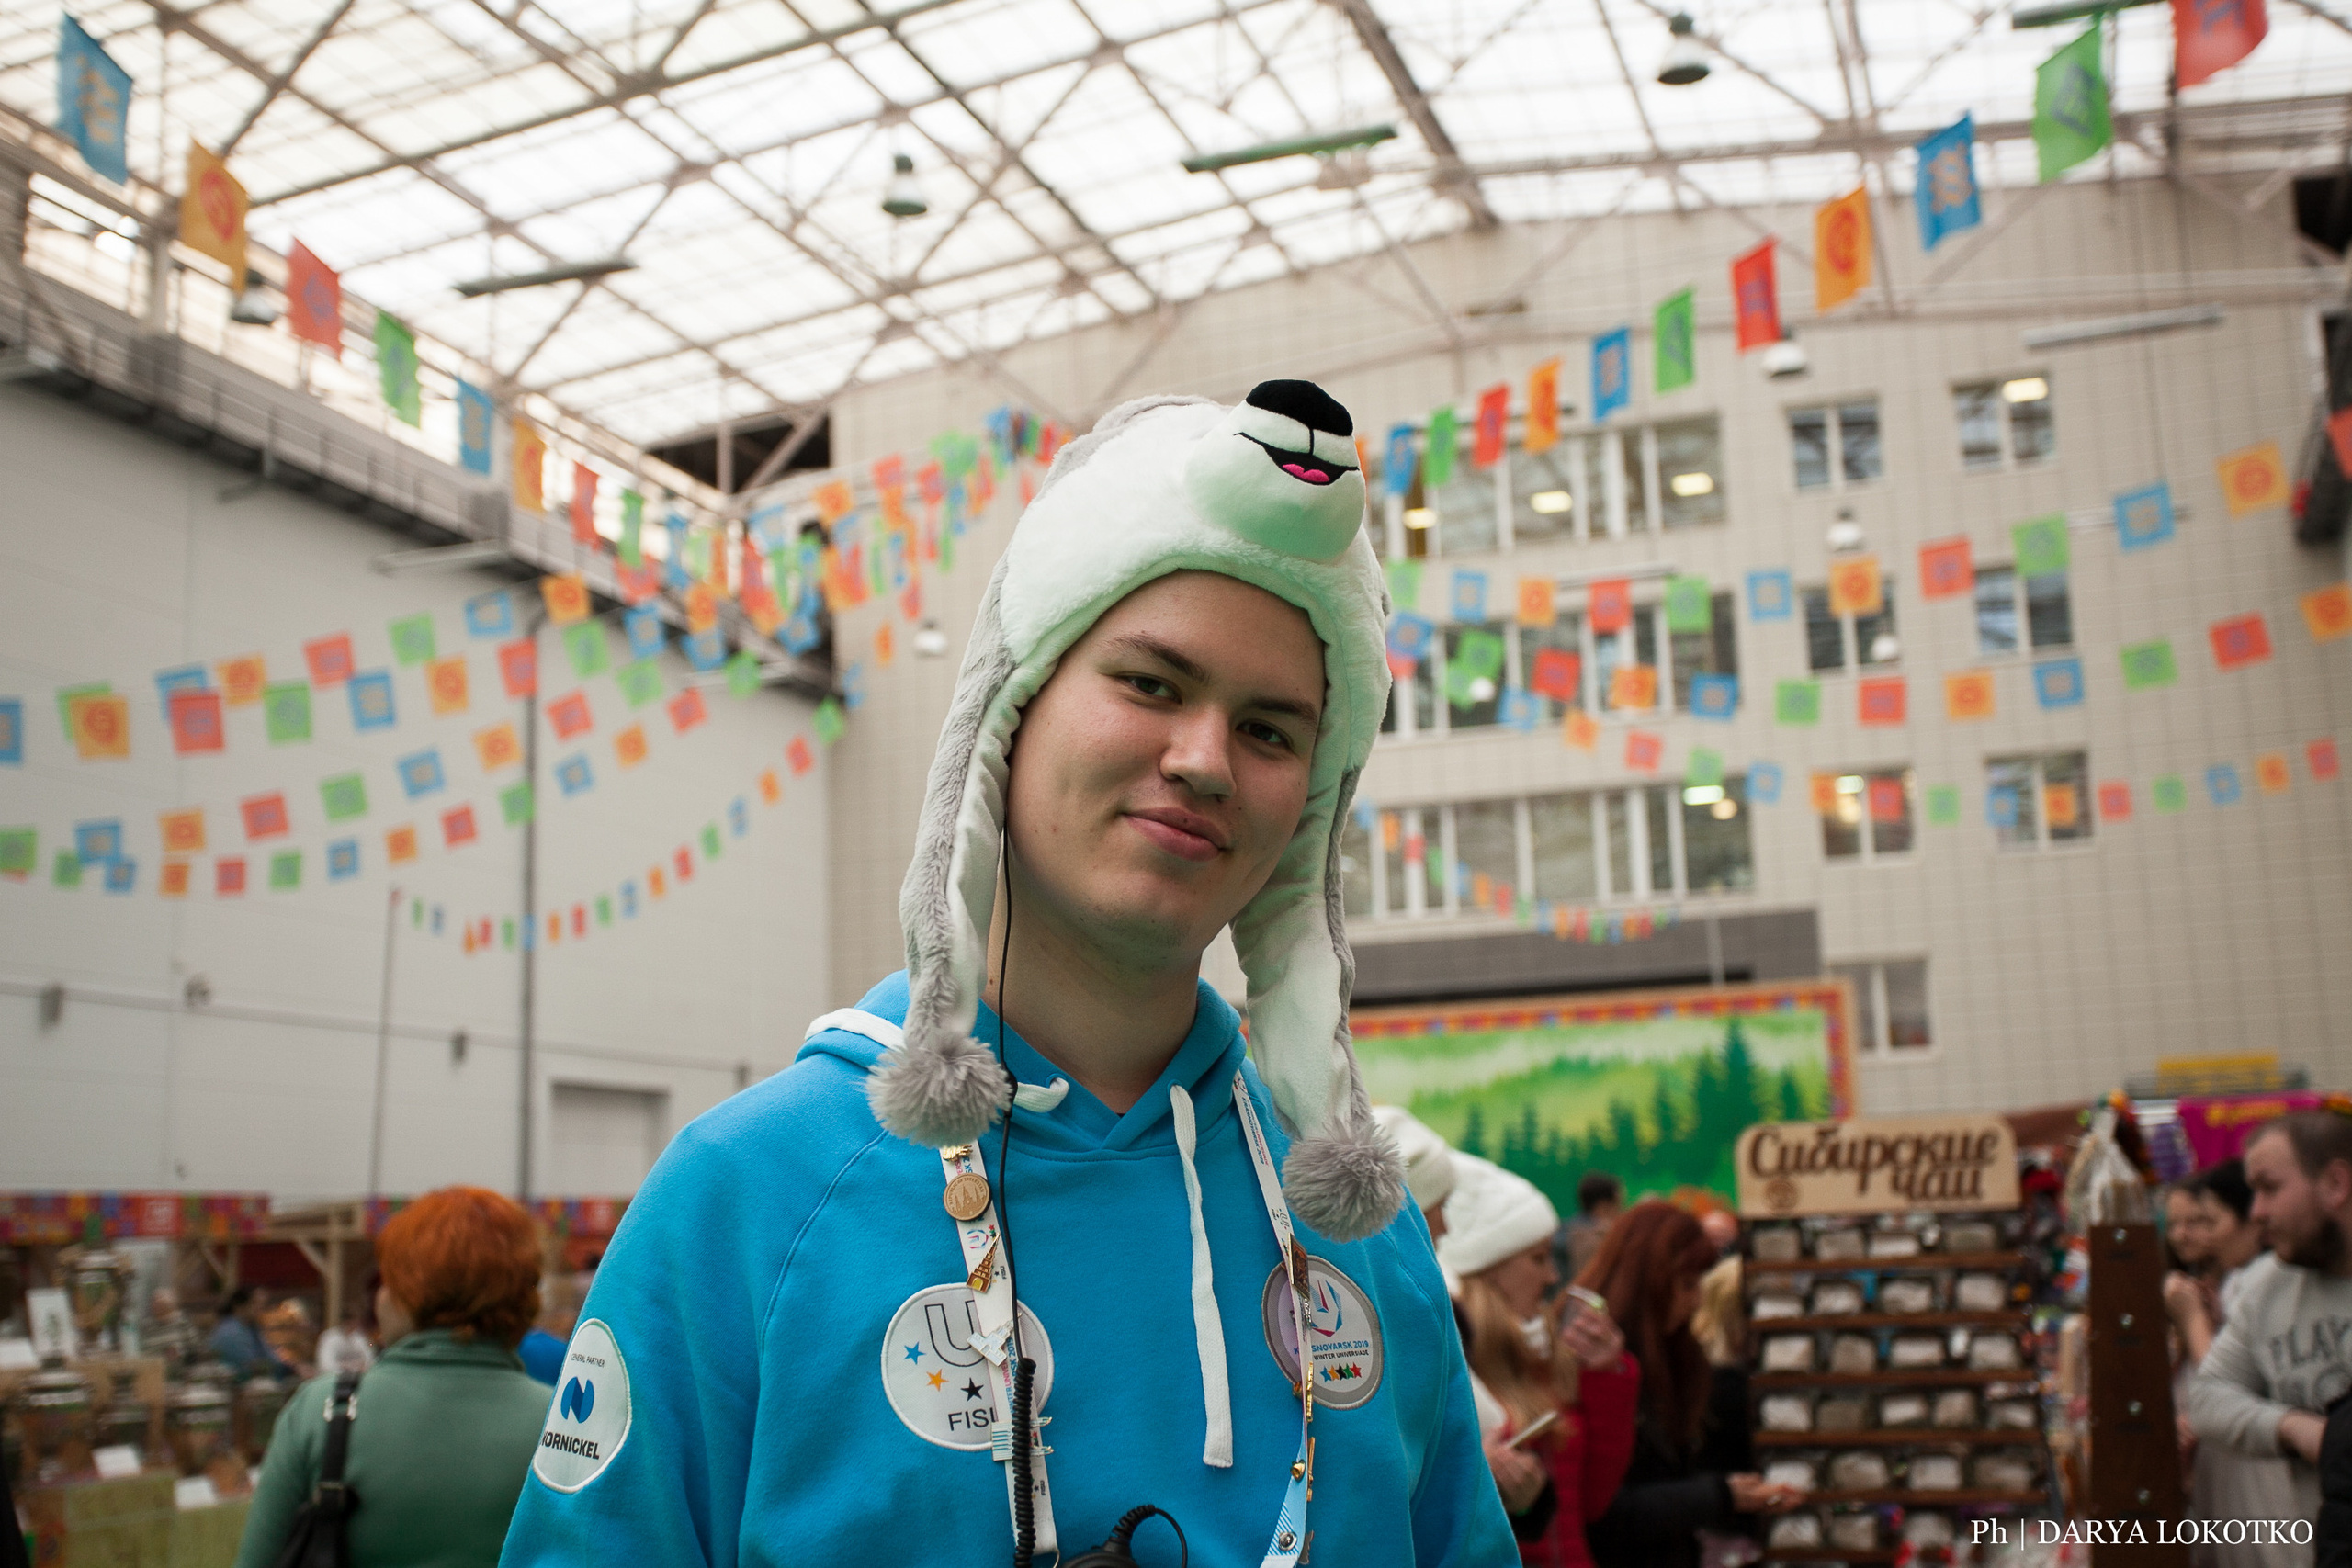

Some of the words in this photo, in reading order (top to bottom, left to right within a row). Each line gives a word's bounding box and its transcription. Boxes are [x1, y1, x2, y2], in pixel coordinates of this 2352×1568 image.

[1748, 1125, 1999, 1195] Сибирские
[1352, 1340, 1369, 1348] 2019
[1336, 1349, 1369, 1359] UNIVERSIADE
[586, 1356, 605, 1368] PARTNER
